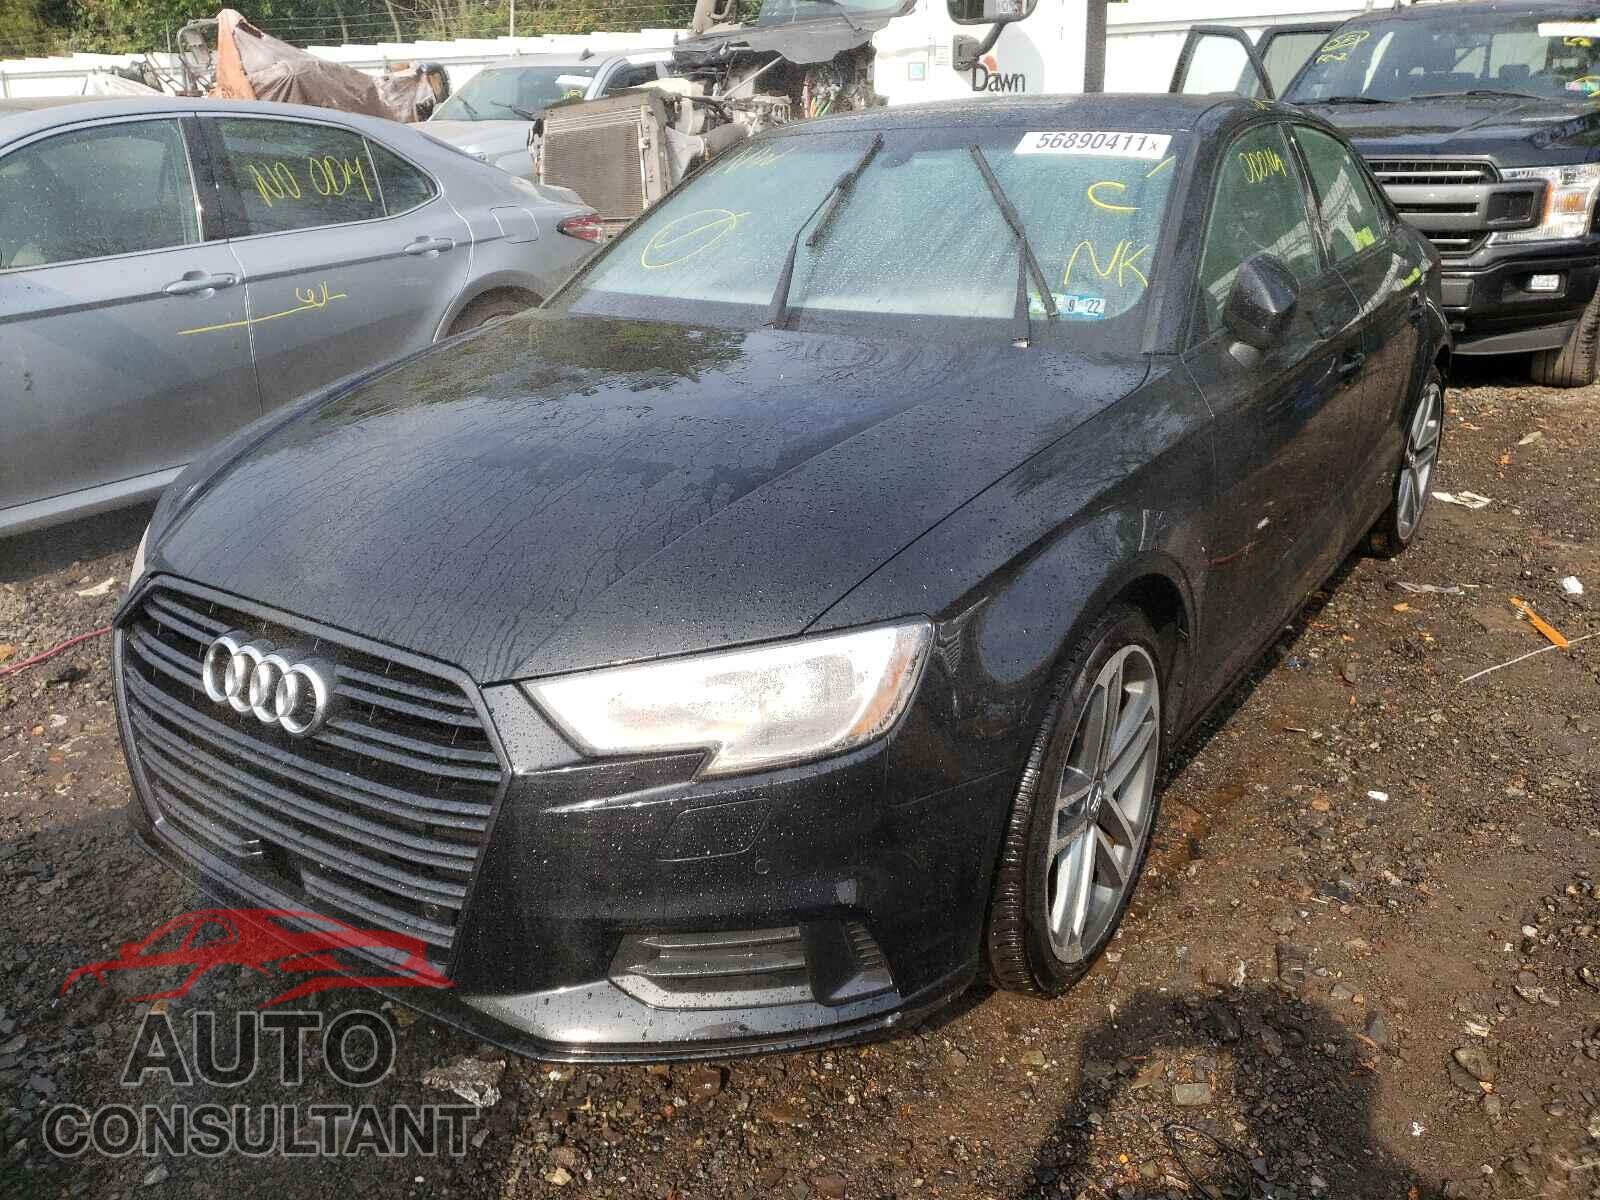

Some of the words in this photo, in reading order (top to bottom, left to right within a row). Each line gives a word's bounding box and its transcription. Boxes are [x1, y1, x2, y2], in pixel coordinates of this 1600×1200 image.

[972, 63, 1026, 92] Dawn
[1063, 240, 1149, 288] NK
[1087, 299, 1101, 314] 22
